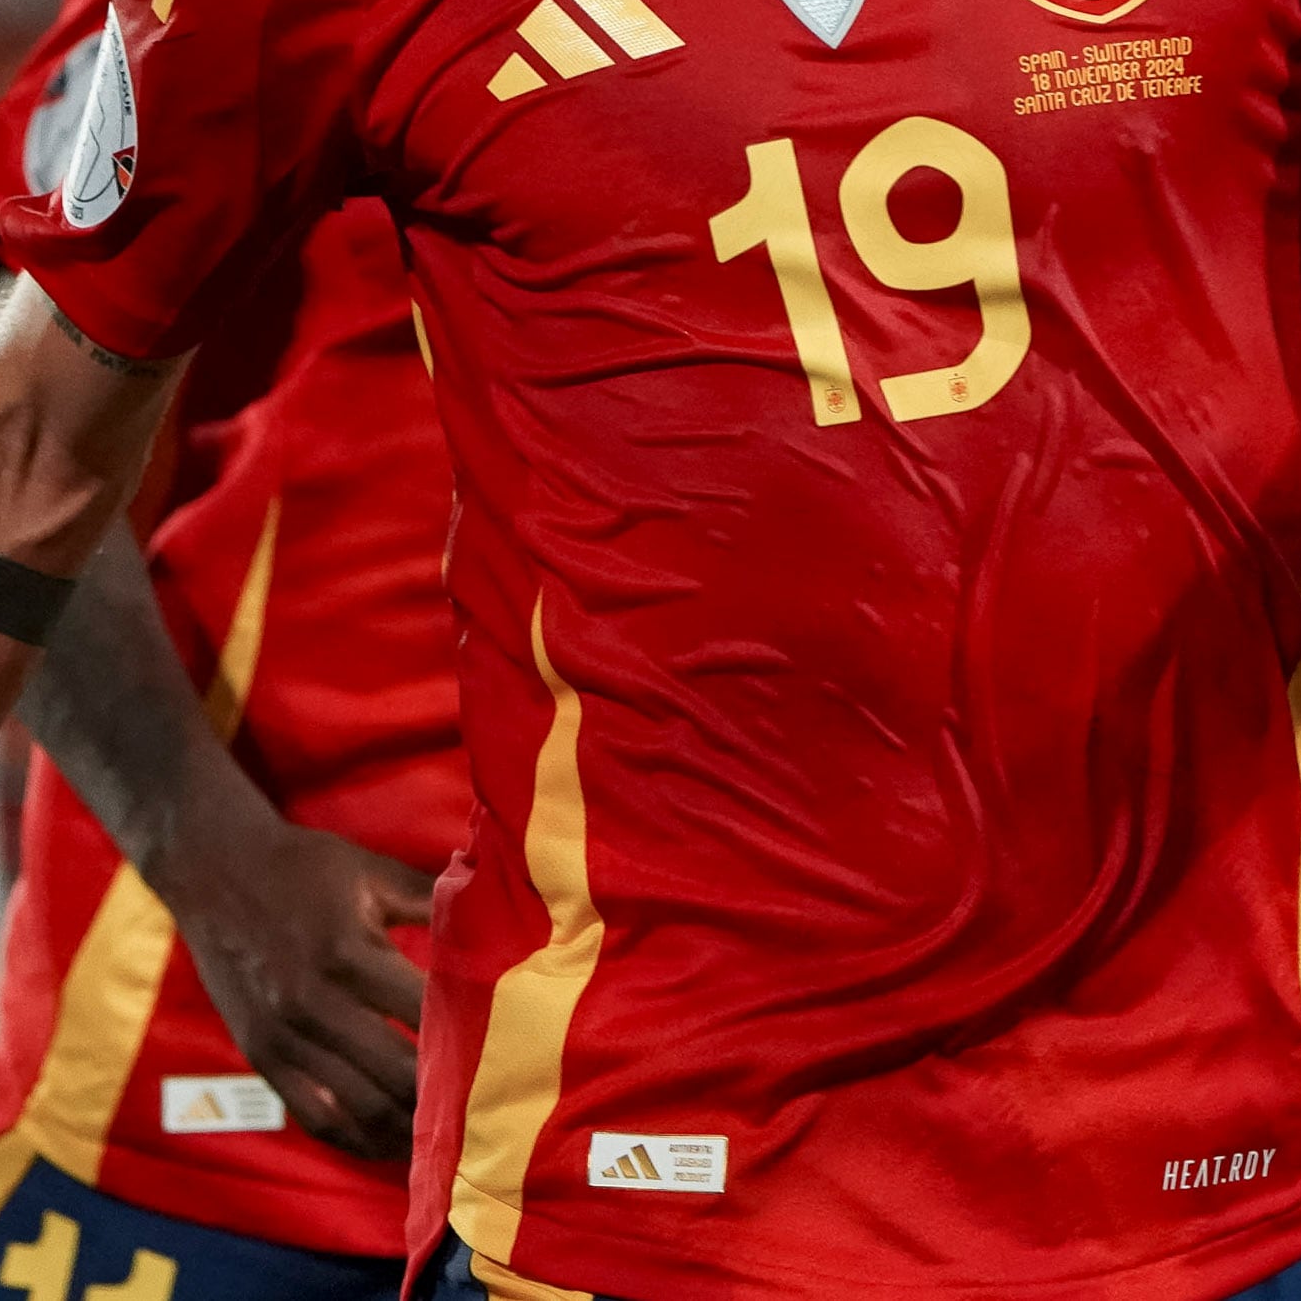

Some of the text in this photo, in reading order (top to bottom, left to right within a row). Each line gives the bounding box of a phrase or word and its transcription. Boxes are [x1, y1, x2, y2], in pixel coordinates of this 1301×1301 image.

[1019, 50, 1067, 73] SPAIN
[1082, 37, 1192, 64] SWITZERLAND
[1031, 57, 1185, 92] 18 NOVEMBER 2024
[1014, 75, 1203, 115] SANTA CRUZ DE TENERIFE
[708, 115, 1032, 427] 19
[1162, 1148, 1276, 1190] HEAT.RDY
